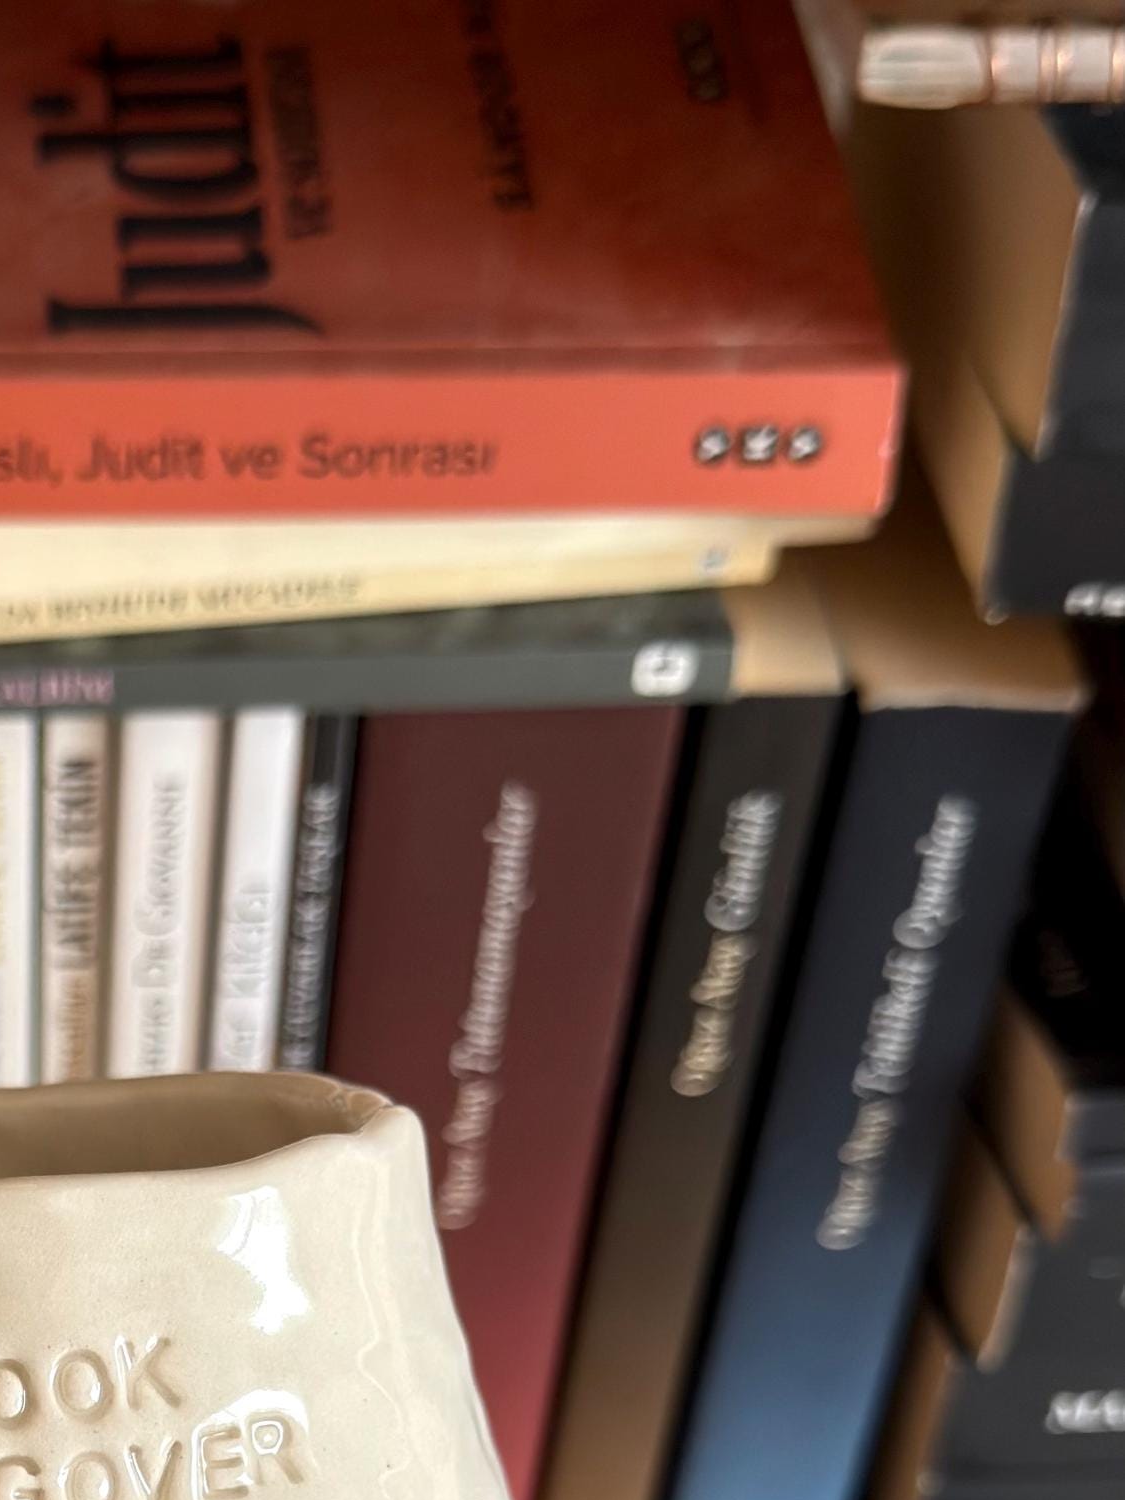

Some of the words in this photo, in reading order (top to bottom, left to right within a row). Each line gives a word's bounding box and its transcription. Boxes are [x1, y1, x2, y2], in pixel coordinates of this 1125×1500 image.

[30, 35, 325, 336] Judit
[78, 428, 204, 483] Judit
[219, 440, 280, 481] ve
[299, 433, 496, 482] Sonrası
